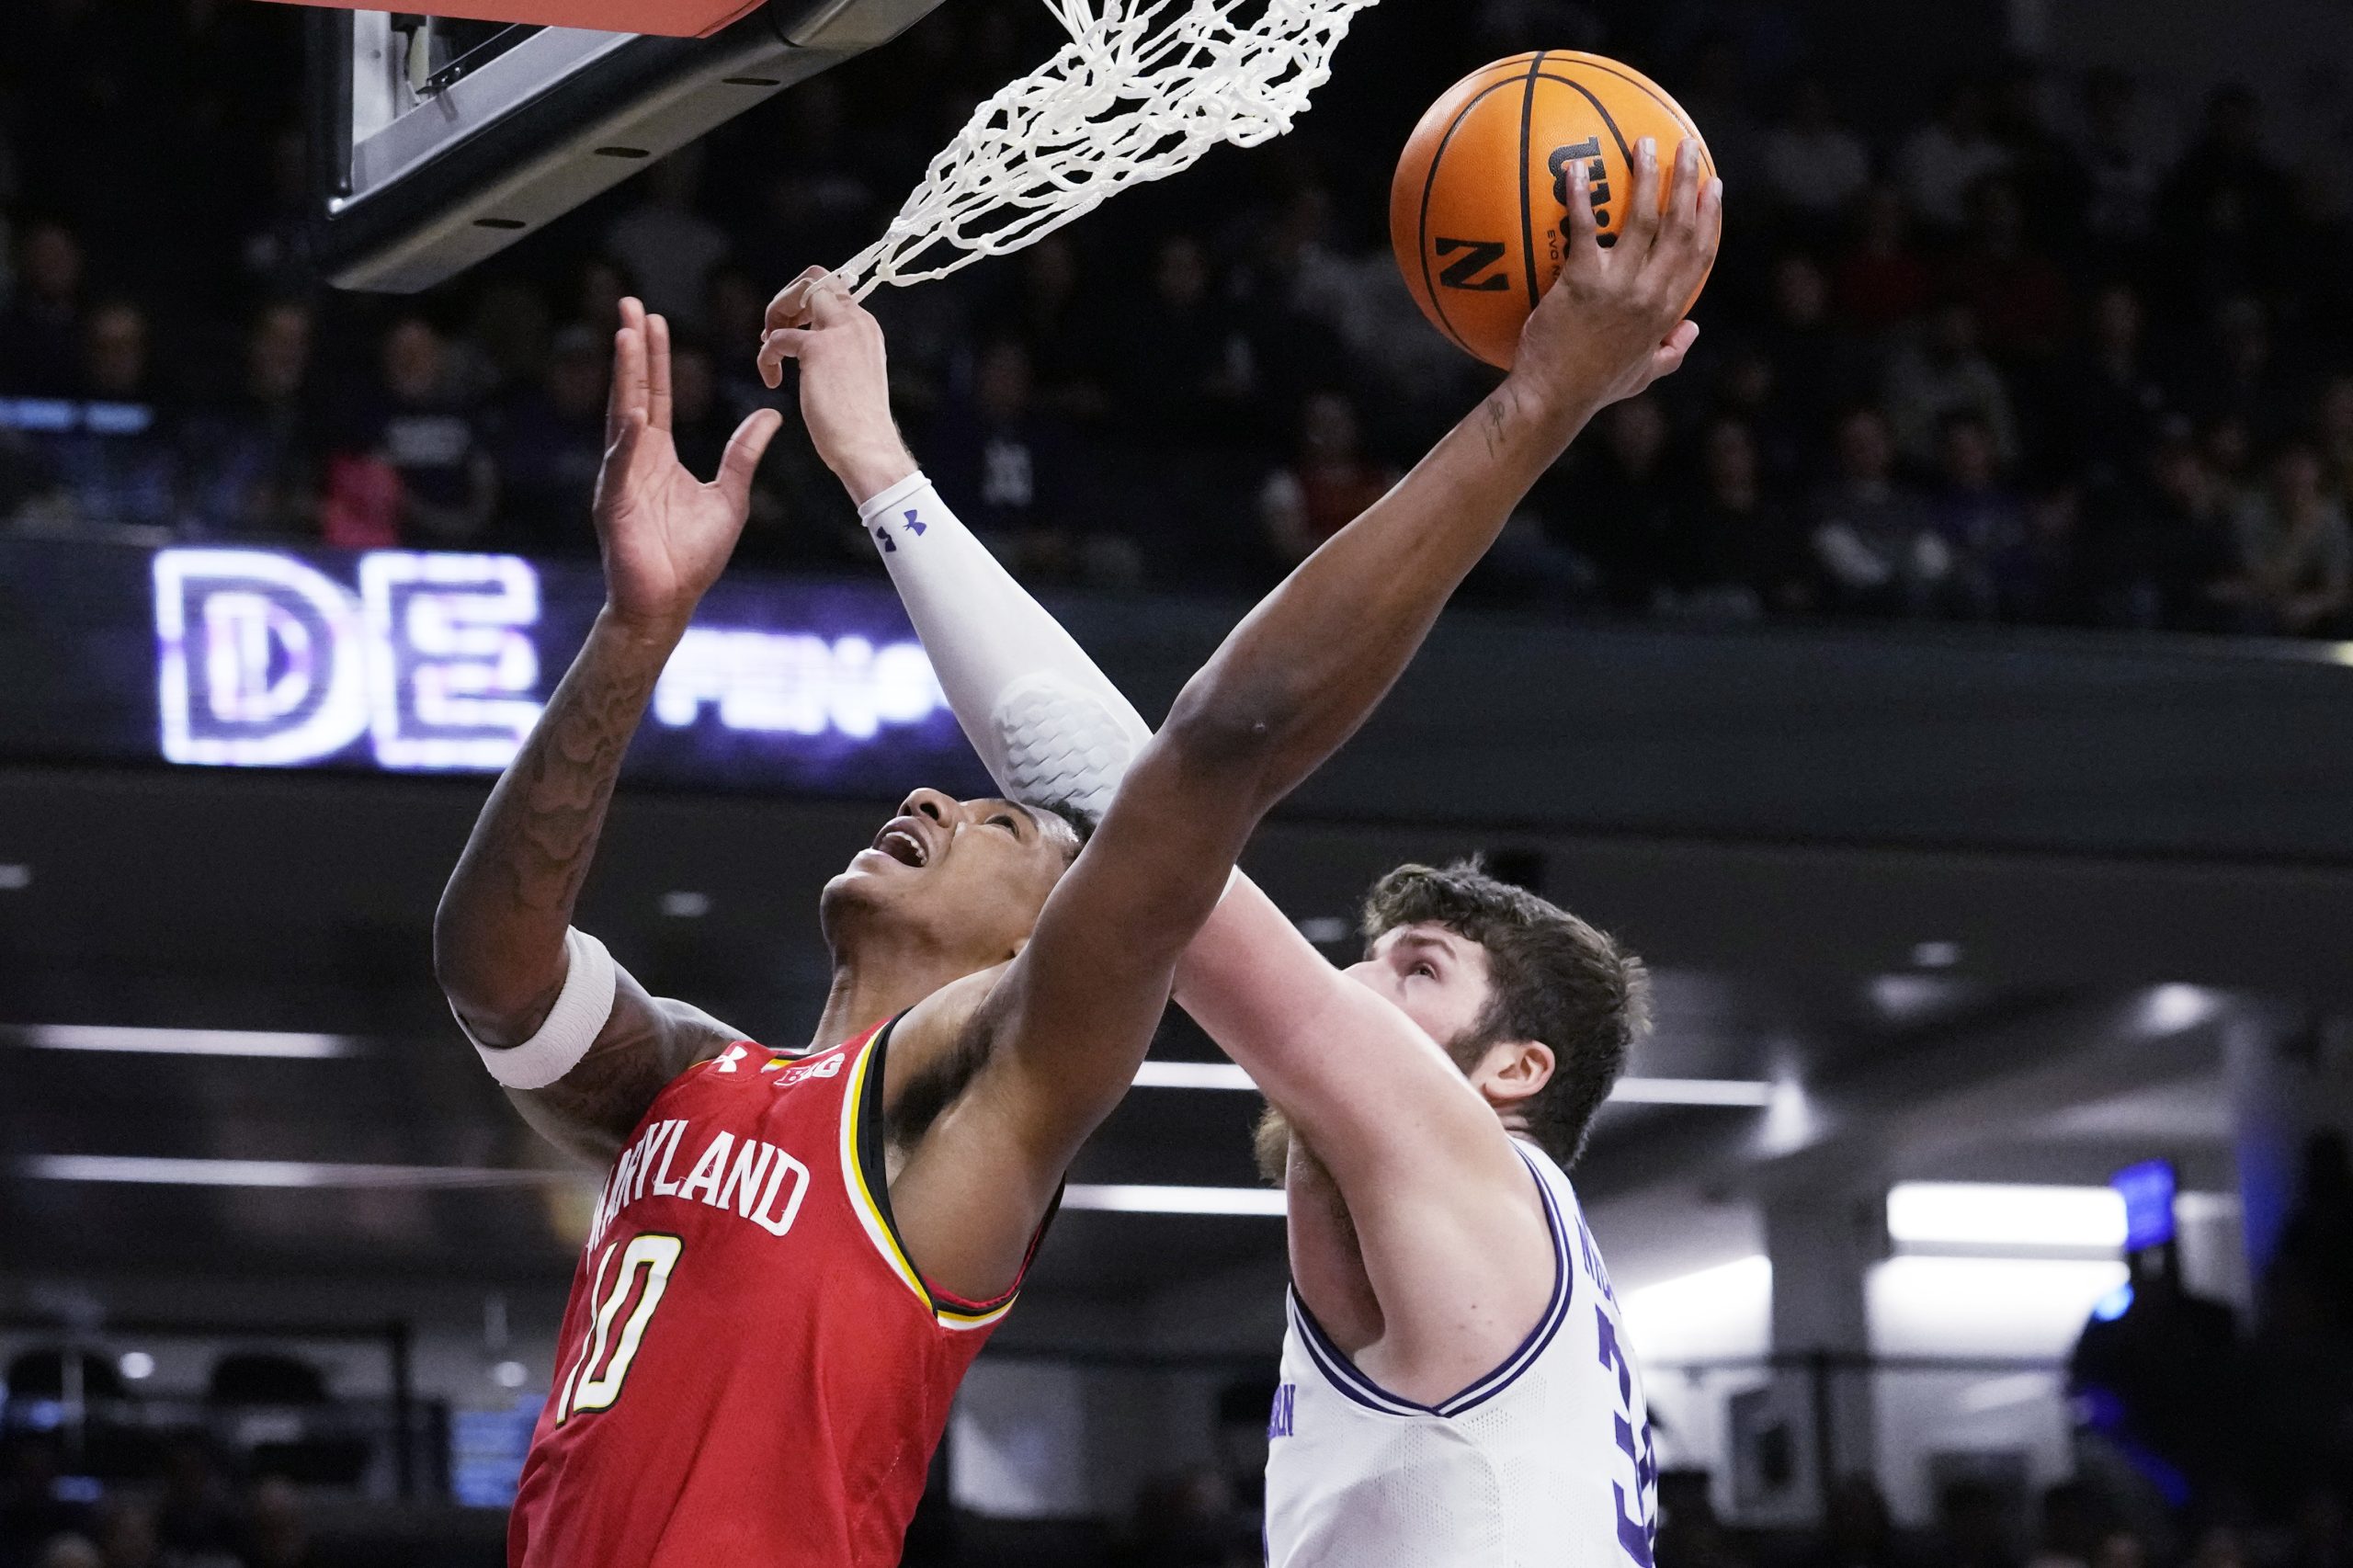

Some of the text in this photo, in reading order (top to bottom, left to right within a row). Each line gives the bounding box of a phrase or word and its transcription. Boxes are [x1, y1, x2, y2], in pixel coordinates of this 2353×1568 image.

[1546, 229, 1560, 261] EVO
[153, 549, 544, 768] DE
[585, 1119, 810, 1275] MARYLAND
[556, 1231, 685, 1429] 10
